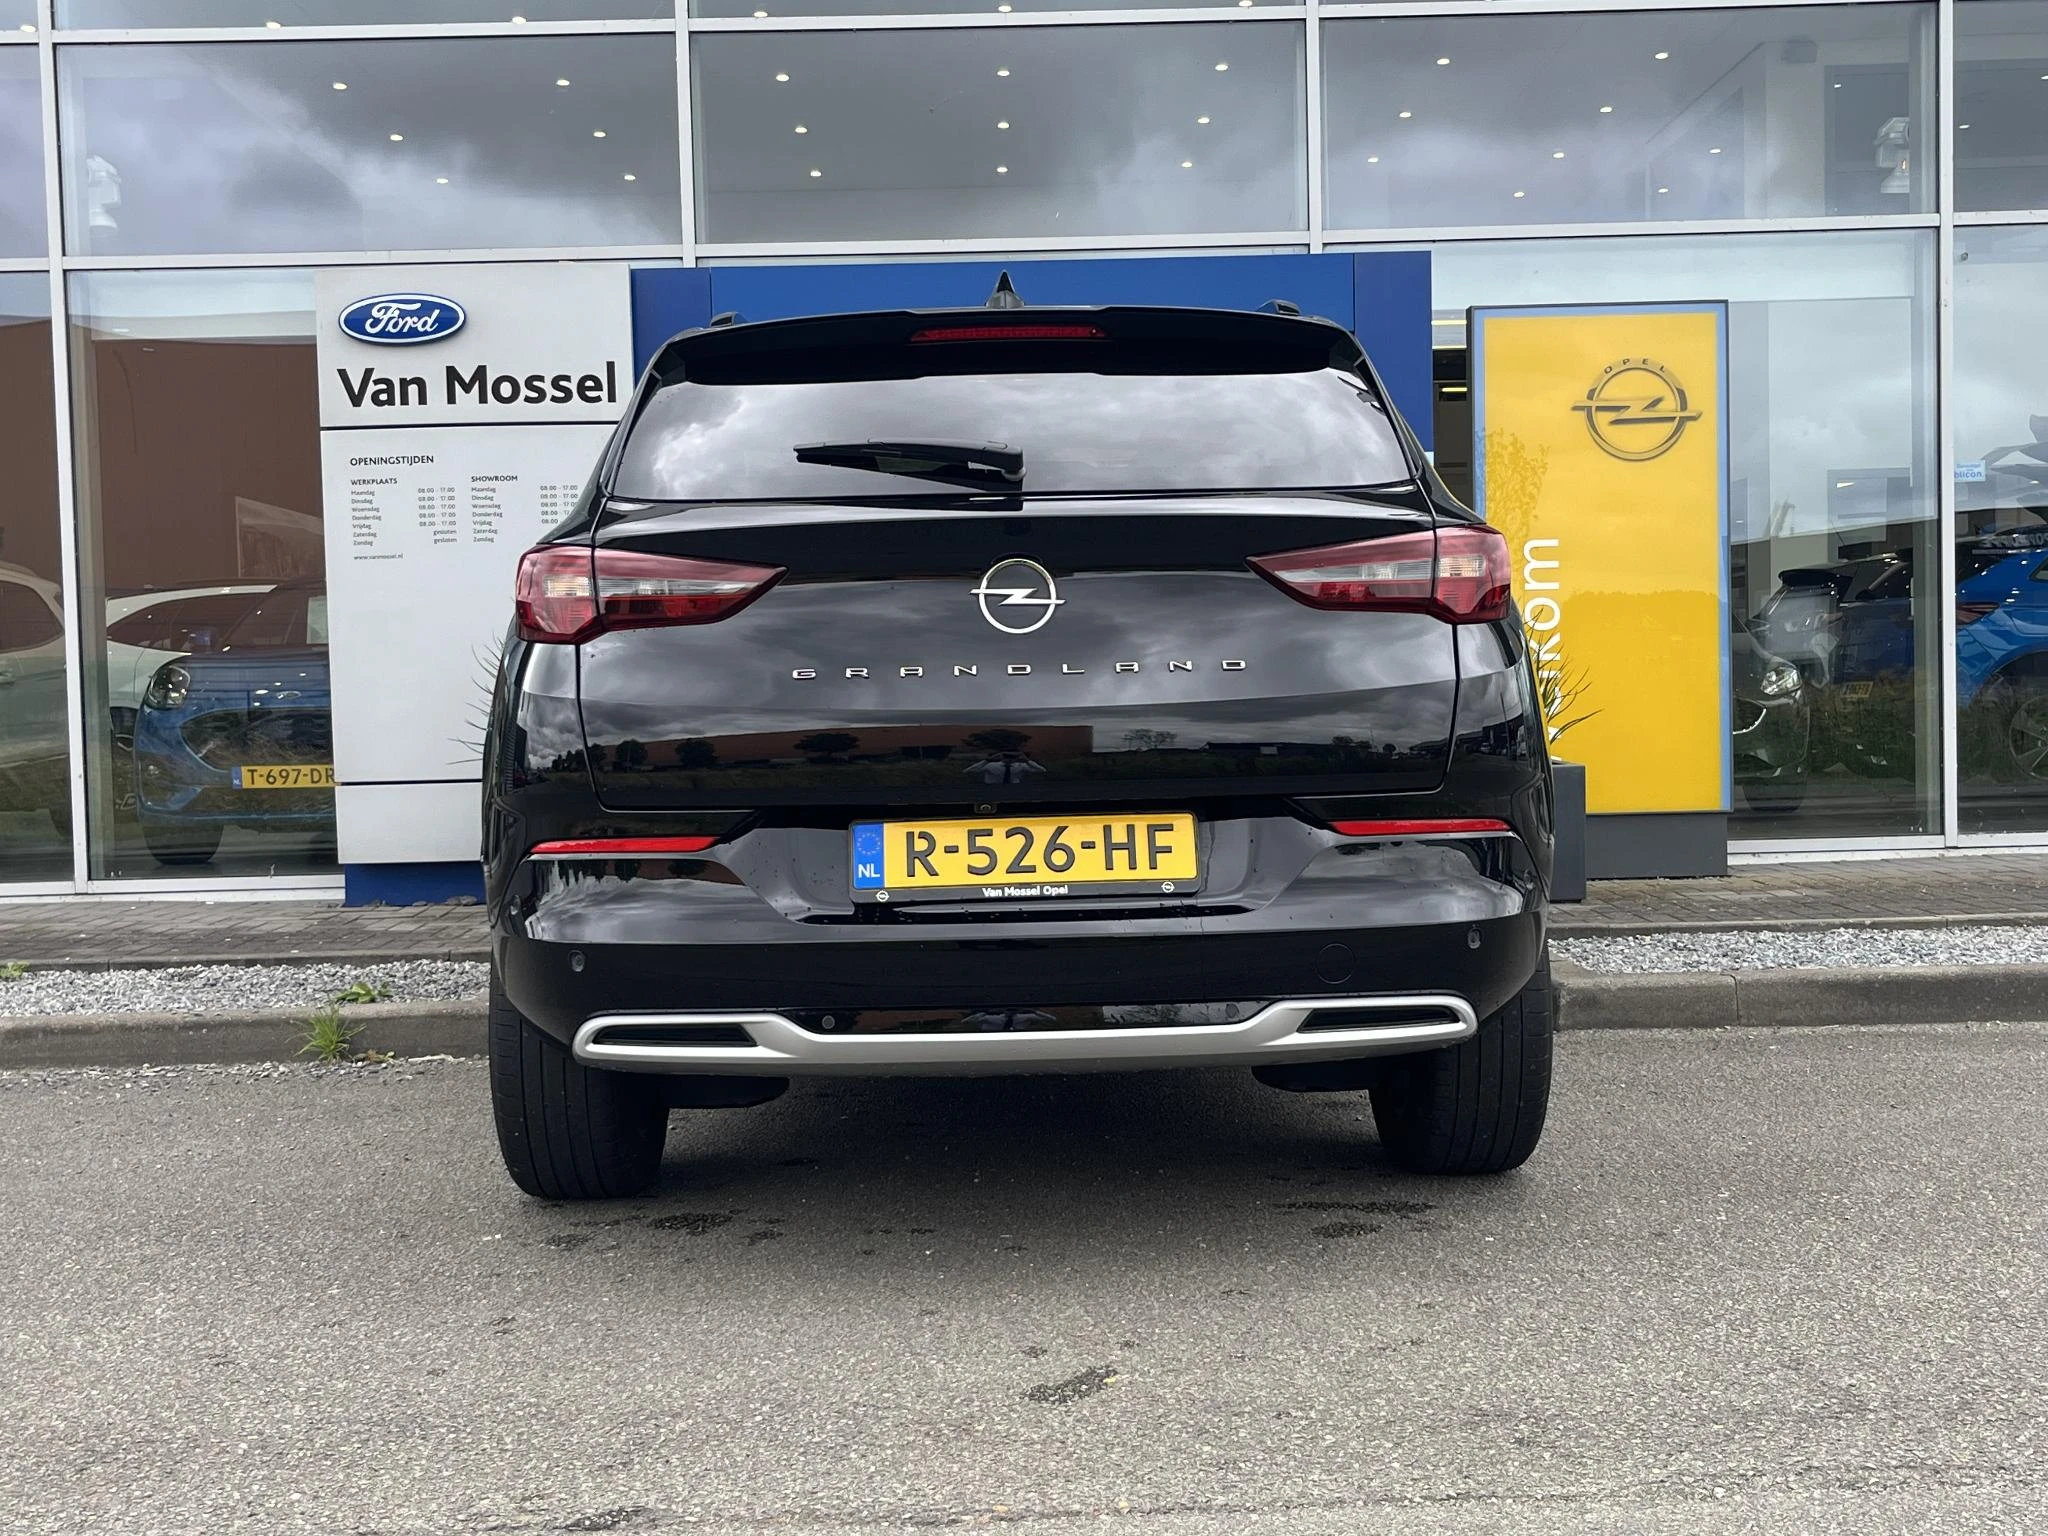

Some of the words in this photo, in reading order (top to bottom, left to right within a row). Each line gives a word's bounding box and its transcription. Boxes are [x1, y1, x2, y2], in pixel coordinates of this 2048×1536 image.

[365, 302, 440, 334] Ford
[1604, 358, 1665, 374] OPEL
[336, 367, 428, 408] Van
[445, 360, 617, 405] Mossel
[350, 455, 435, 466] OPENINGSTIJDEN
[350, 477, 398, 486] WERKPLAATS
[792, 659, 1246, 679] GRANDLAND
[905, 823, 1175, 878] R-526-HF
[858, 863, 880, 878] NL
[982, 887, 1002, 897] Van
[1004, 885, 1041, 897] Mossel
[1043, 885, 1069, 896] Opel
